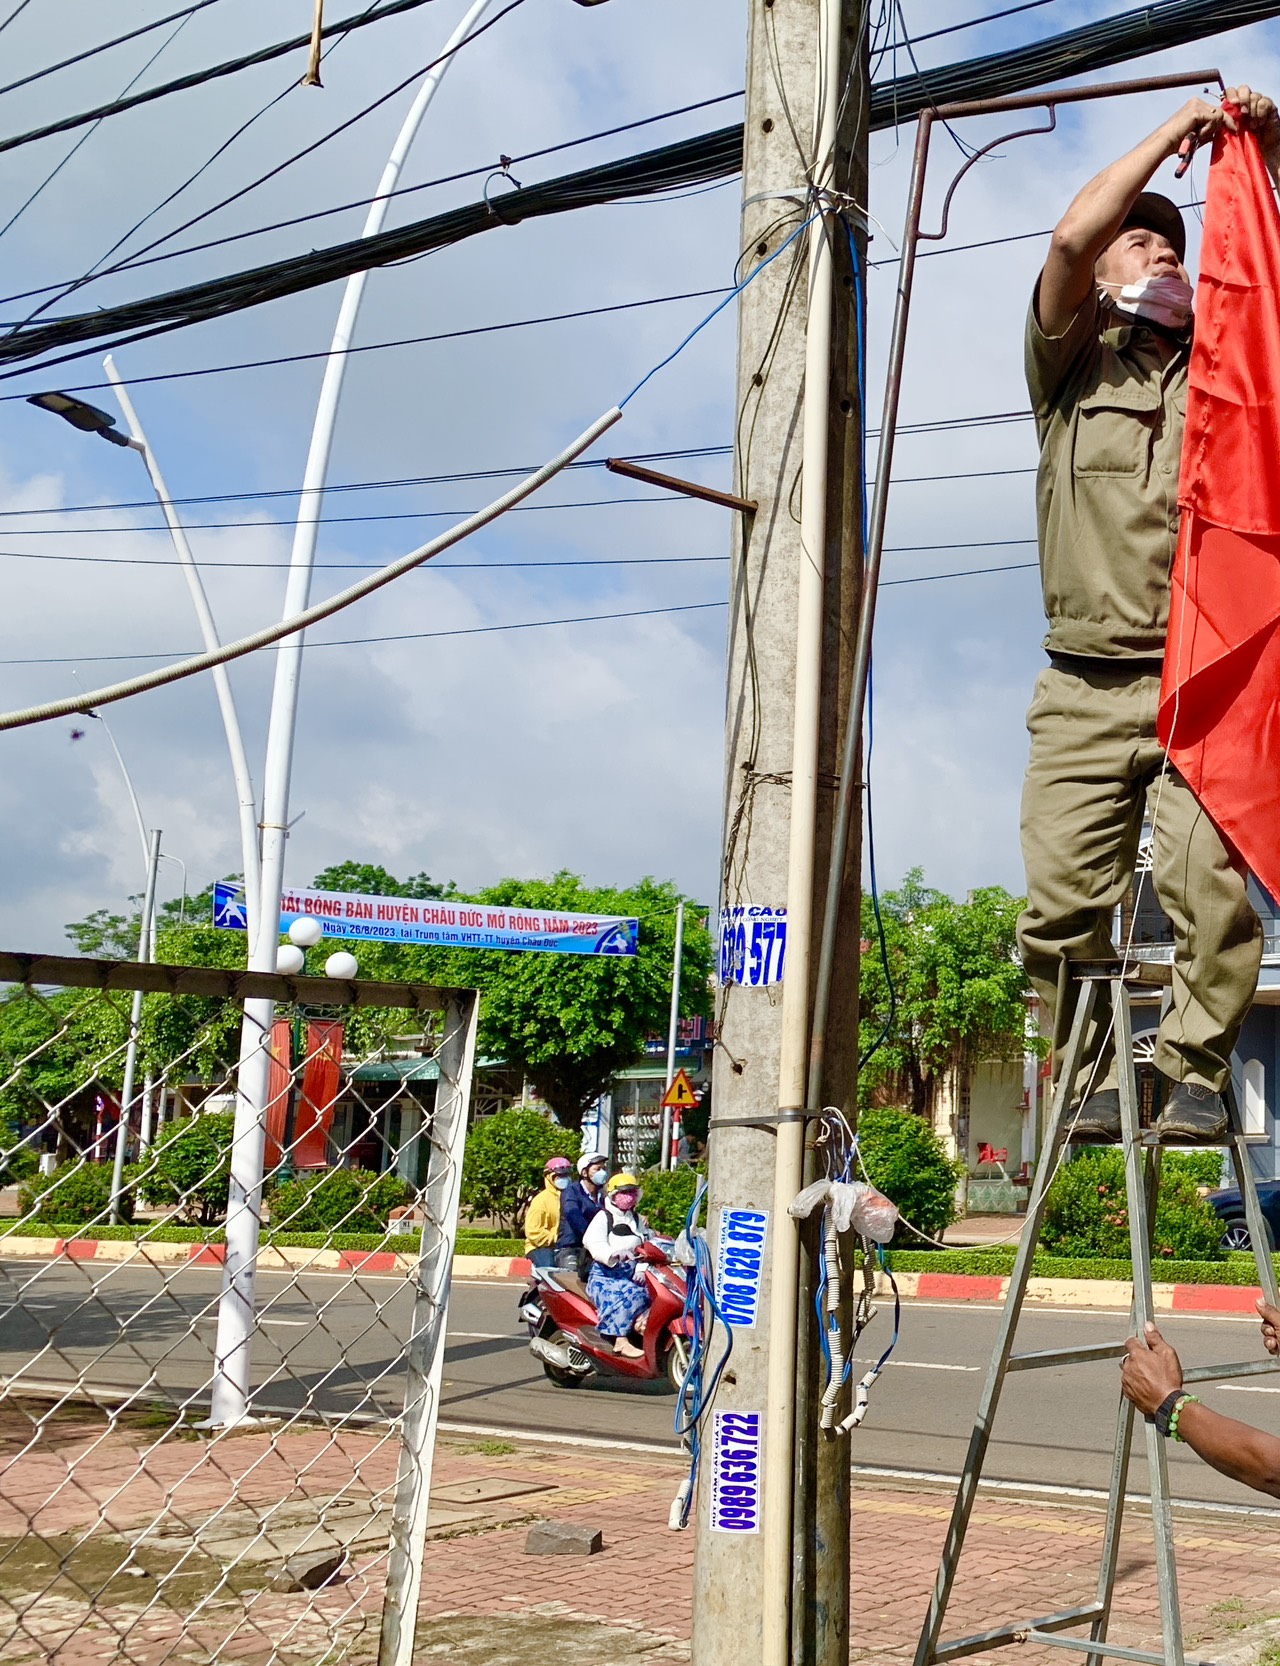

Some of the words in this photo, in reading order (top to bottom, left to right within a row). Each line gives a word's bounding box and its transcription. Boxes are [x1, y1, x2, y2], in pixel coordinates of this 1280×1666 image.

[280, 890, 300, 913] IẢI
[304, 895, 342, 917] BÓNG
[346, 899, 373, 920] BÀN
[377, 903, 419, 926] HUYỆN
[423, 906, 456, 926] CHÂU
[459, 909, 484, 928] ĐỨC
[487, 909, 506, 930] MỞ
[509, 912, 541, 934] RỘNG
[543, 915, 570, 934] NĂM
[572, 920, 599, 936] 2023
[460, 932, 494, 943] VHTT-TT
[720, 1211, 766, 1325] 0708.828.879
[718, 1413, 759, 1530] 0989.636.722
